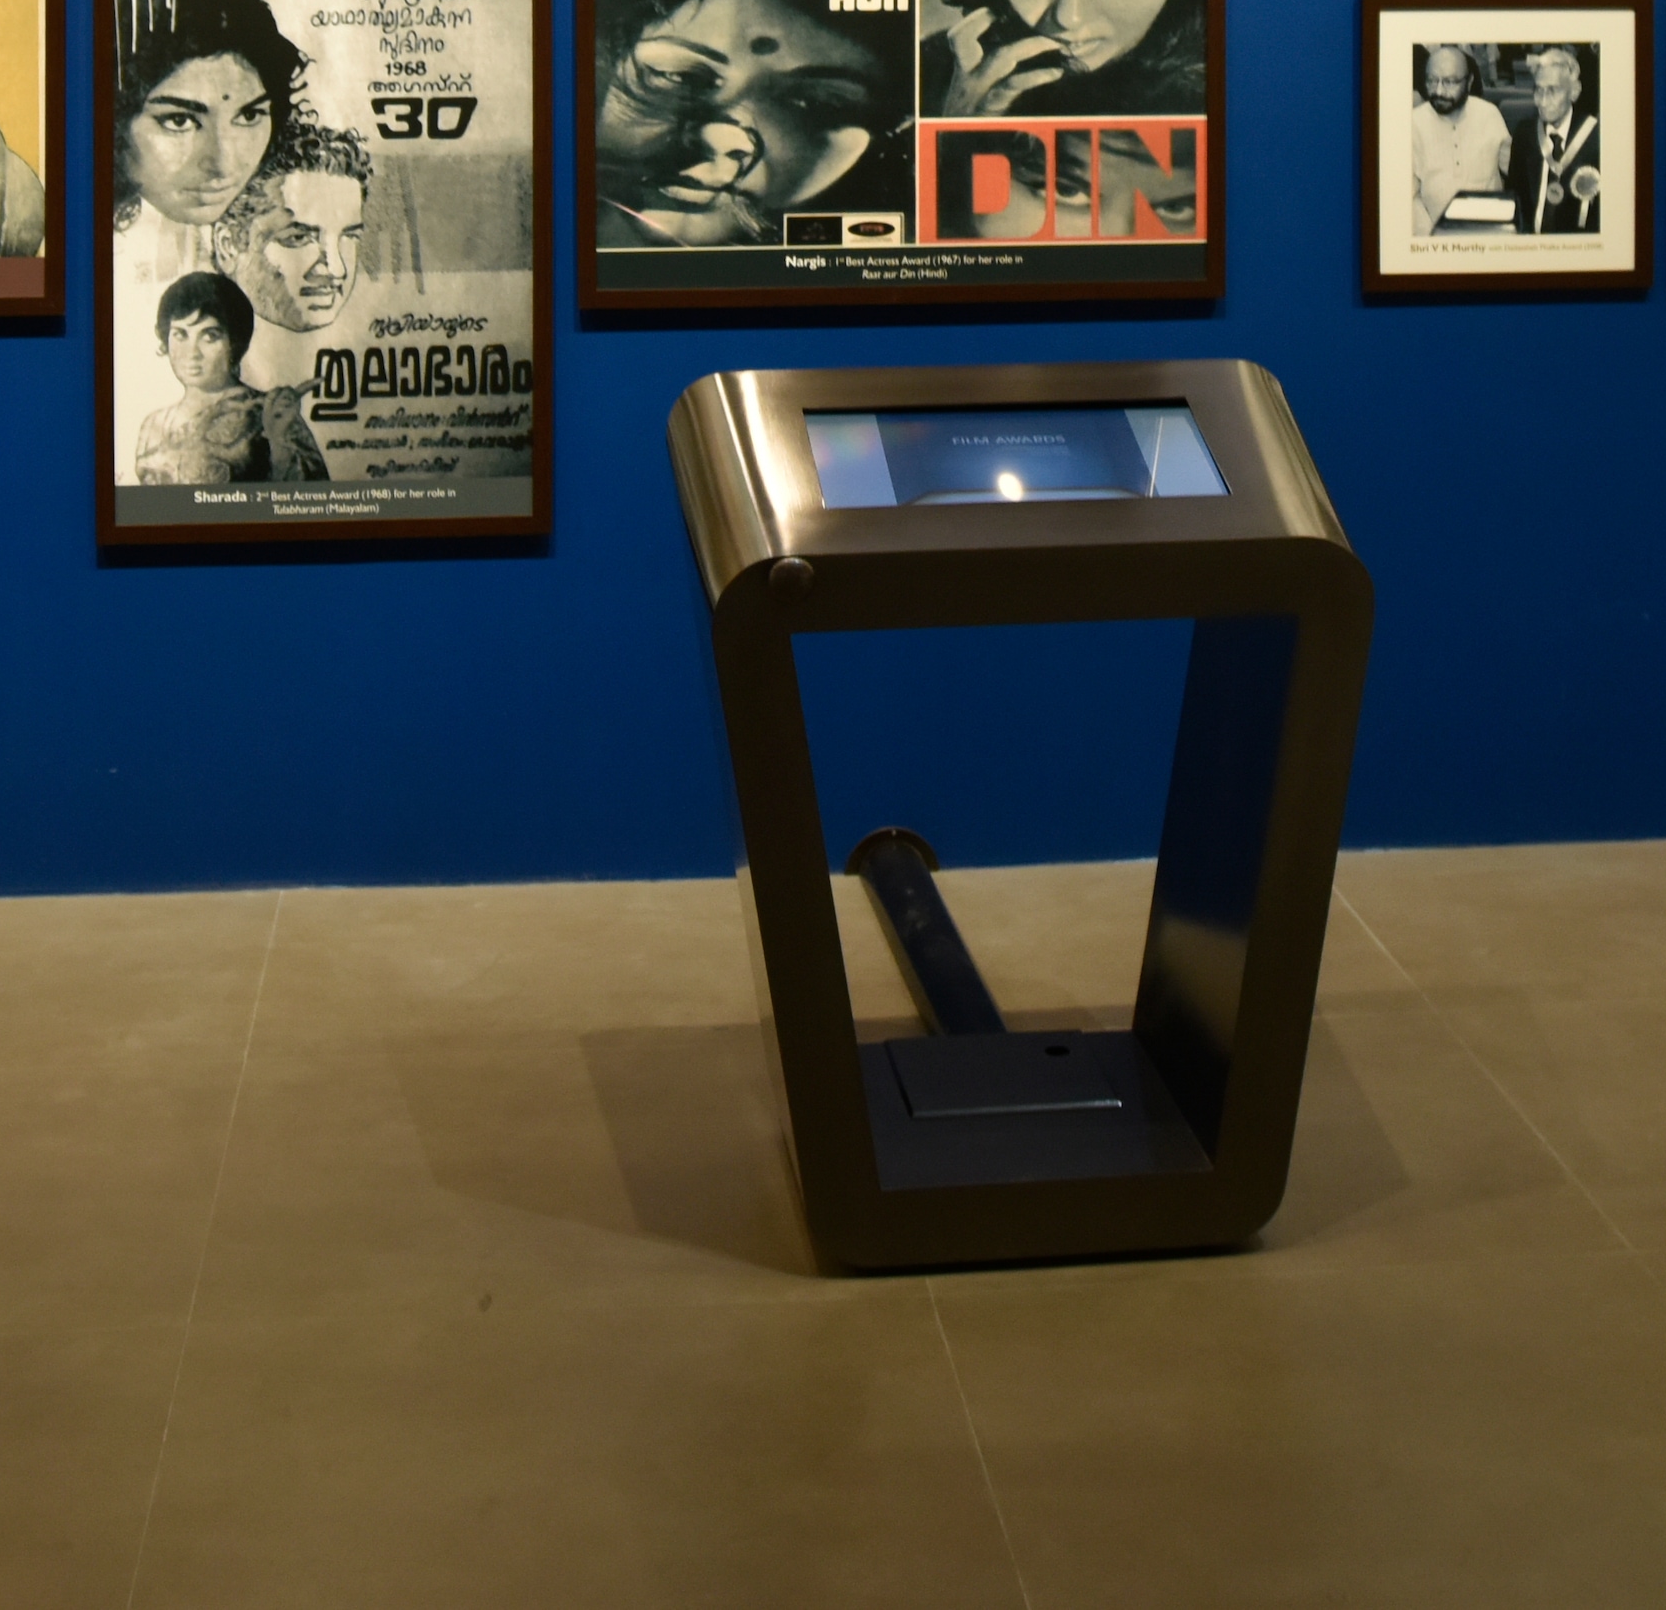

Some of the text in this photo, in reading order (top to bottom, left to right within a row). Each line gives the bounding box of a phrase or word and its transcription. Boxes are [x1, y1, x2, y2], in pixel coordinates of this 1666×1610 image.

[386, 62, 427, 76] 1968
[371, 96, 479, 140] 30
[936, 127, 1197, 238] DIN
[784, 255, 827, 271] Nargis
[952, 434, 1065, 446] FILM AWARDS
[193, 490, 248, 504] Sharada
